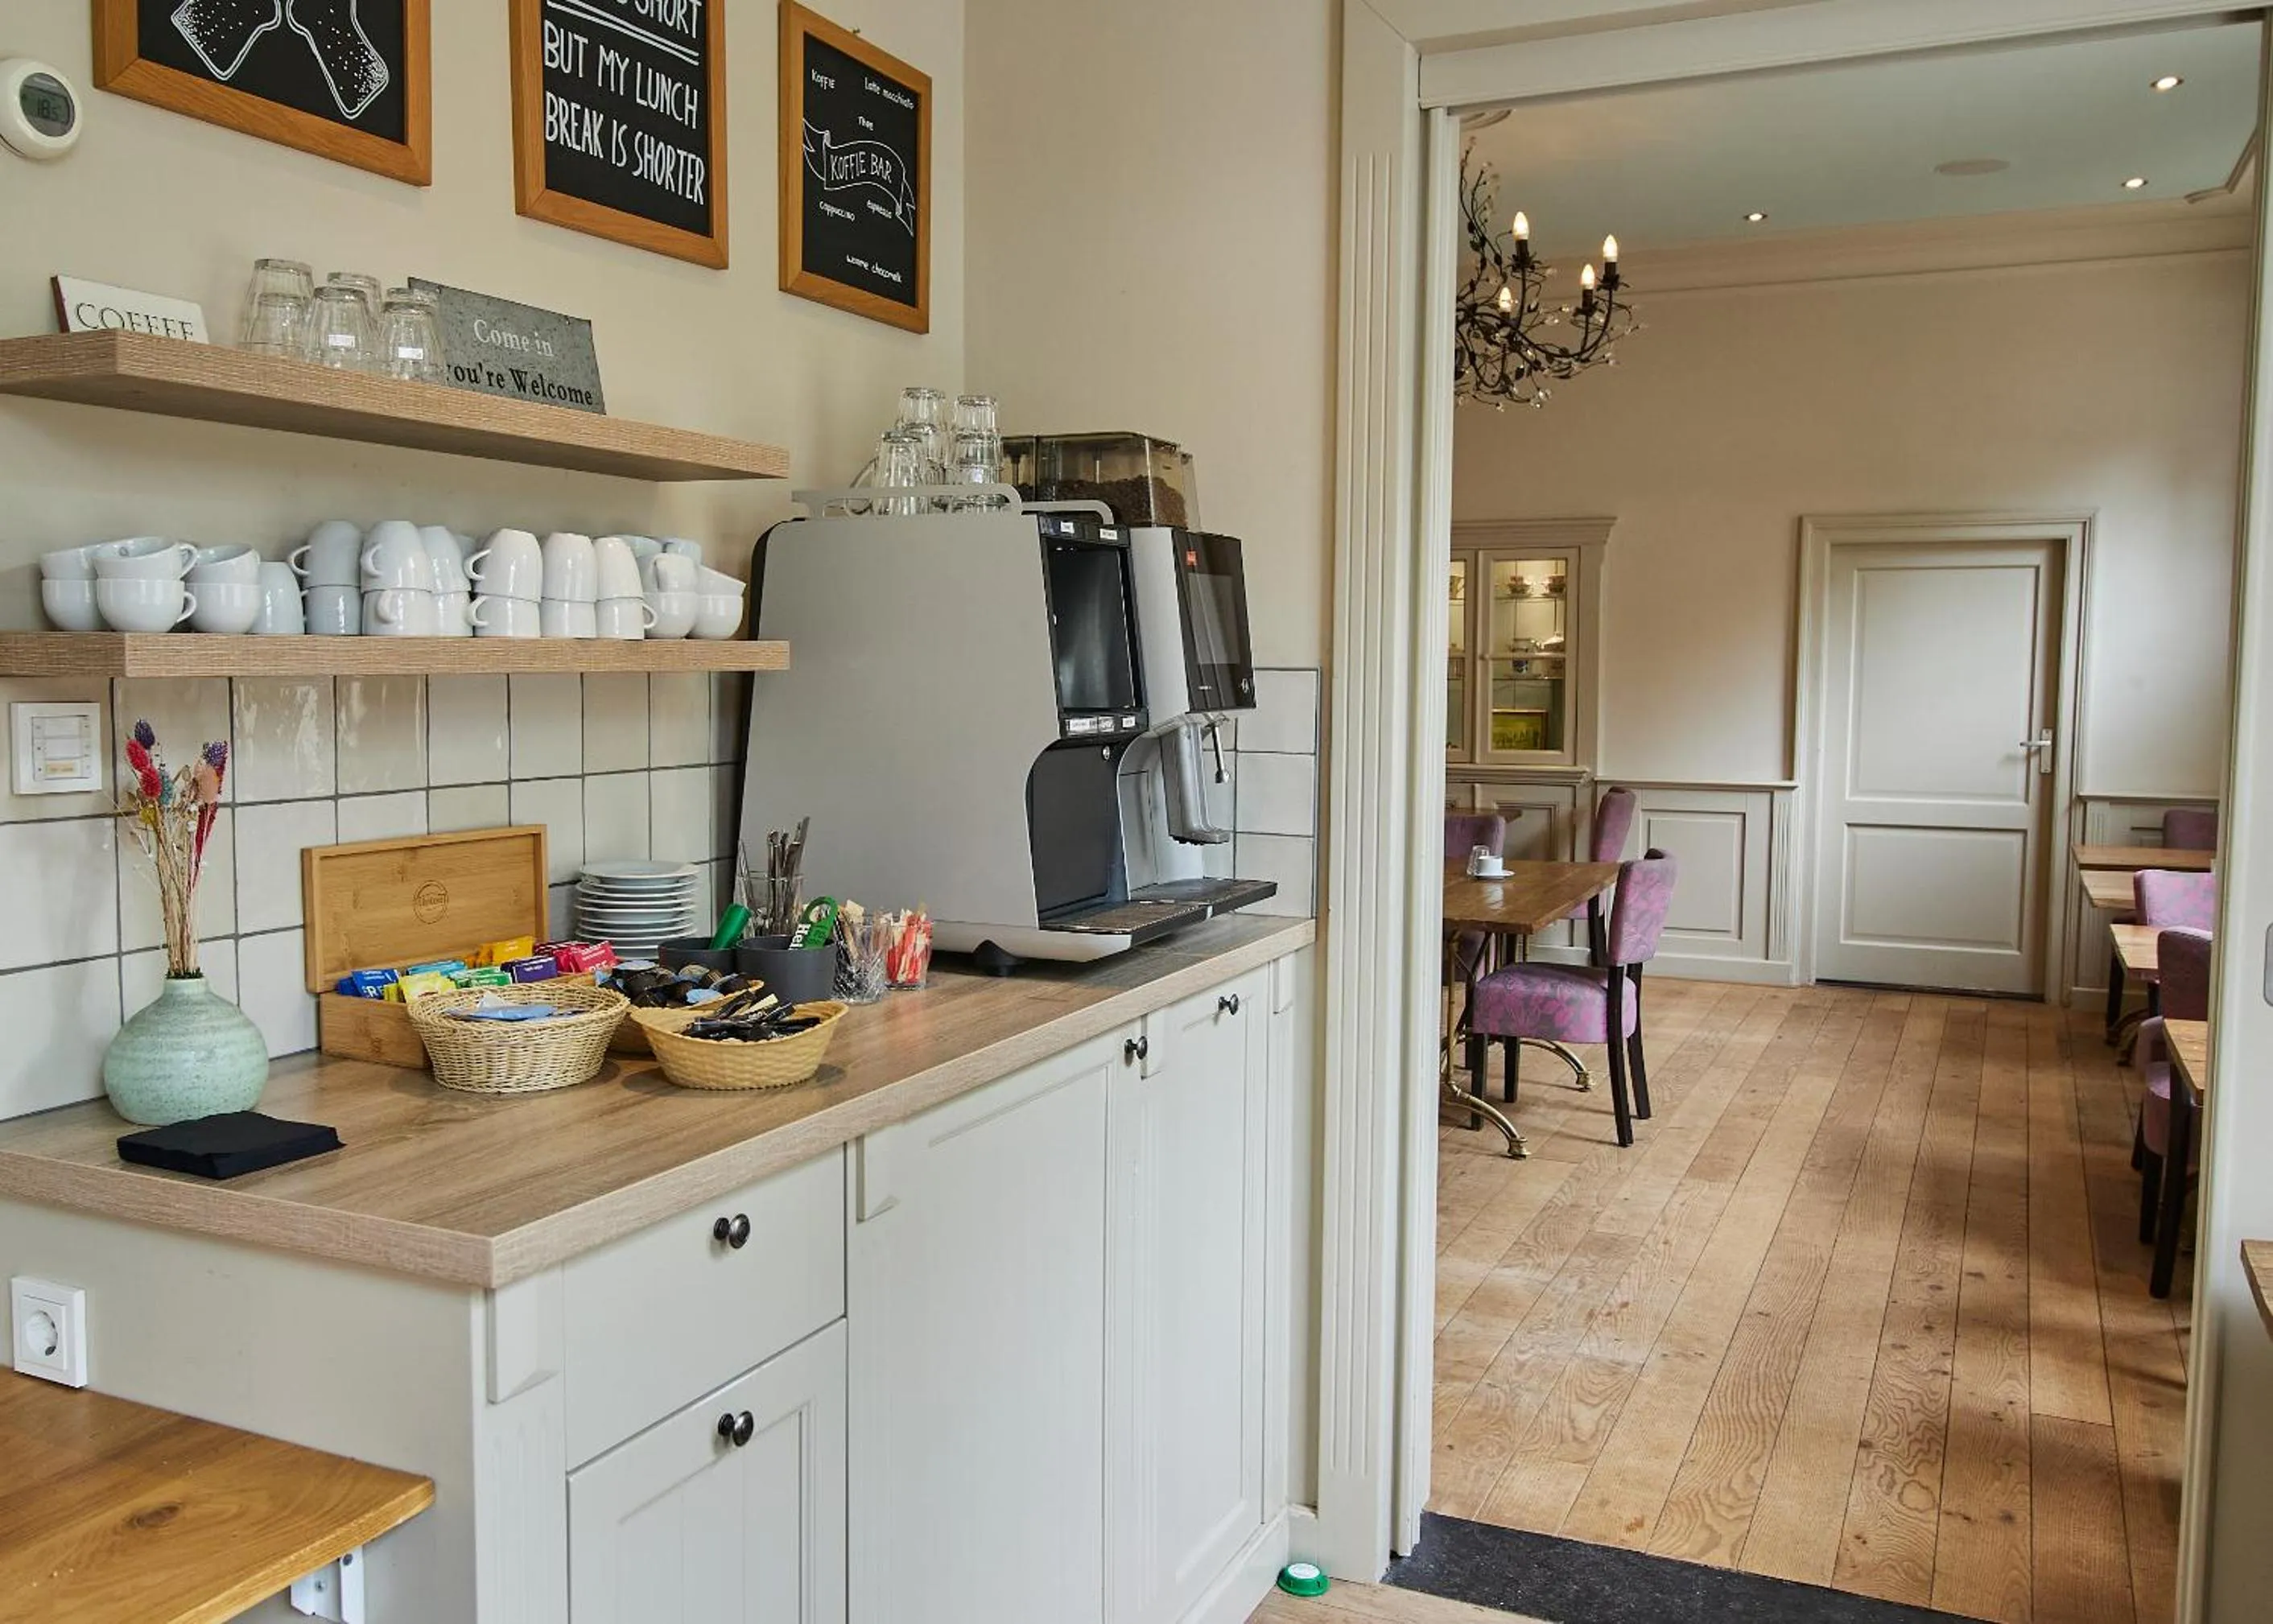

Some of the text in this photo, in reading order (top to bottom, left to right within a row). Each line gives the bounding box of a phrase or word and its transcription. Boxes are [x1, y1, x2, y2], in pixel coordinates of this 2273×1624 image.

[544, 19, 698, 130] BUT MY LUNCH
[545, 90, 705, 205] BREAK IS SHORTER
[830, 150, 893, 184] KOFFIE BAR
[76, 302, 193, 340] COFFEE
[473, 319, 555, 357] Come in
[446, 361, 593, 406] ou're Welcome
